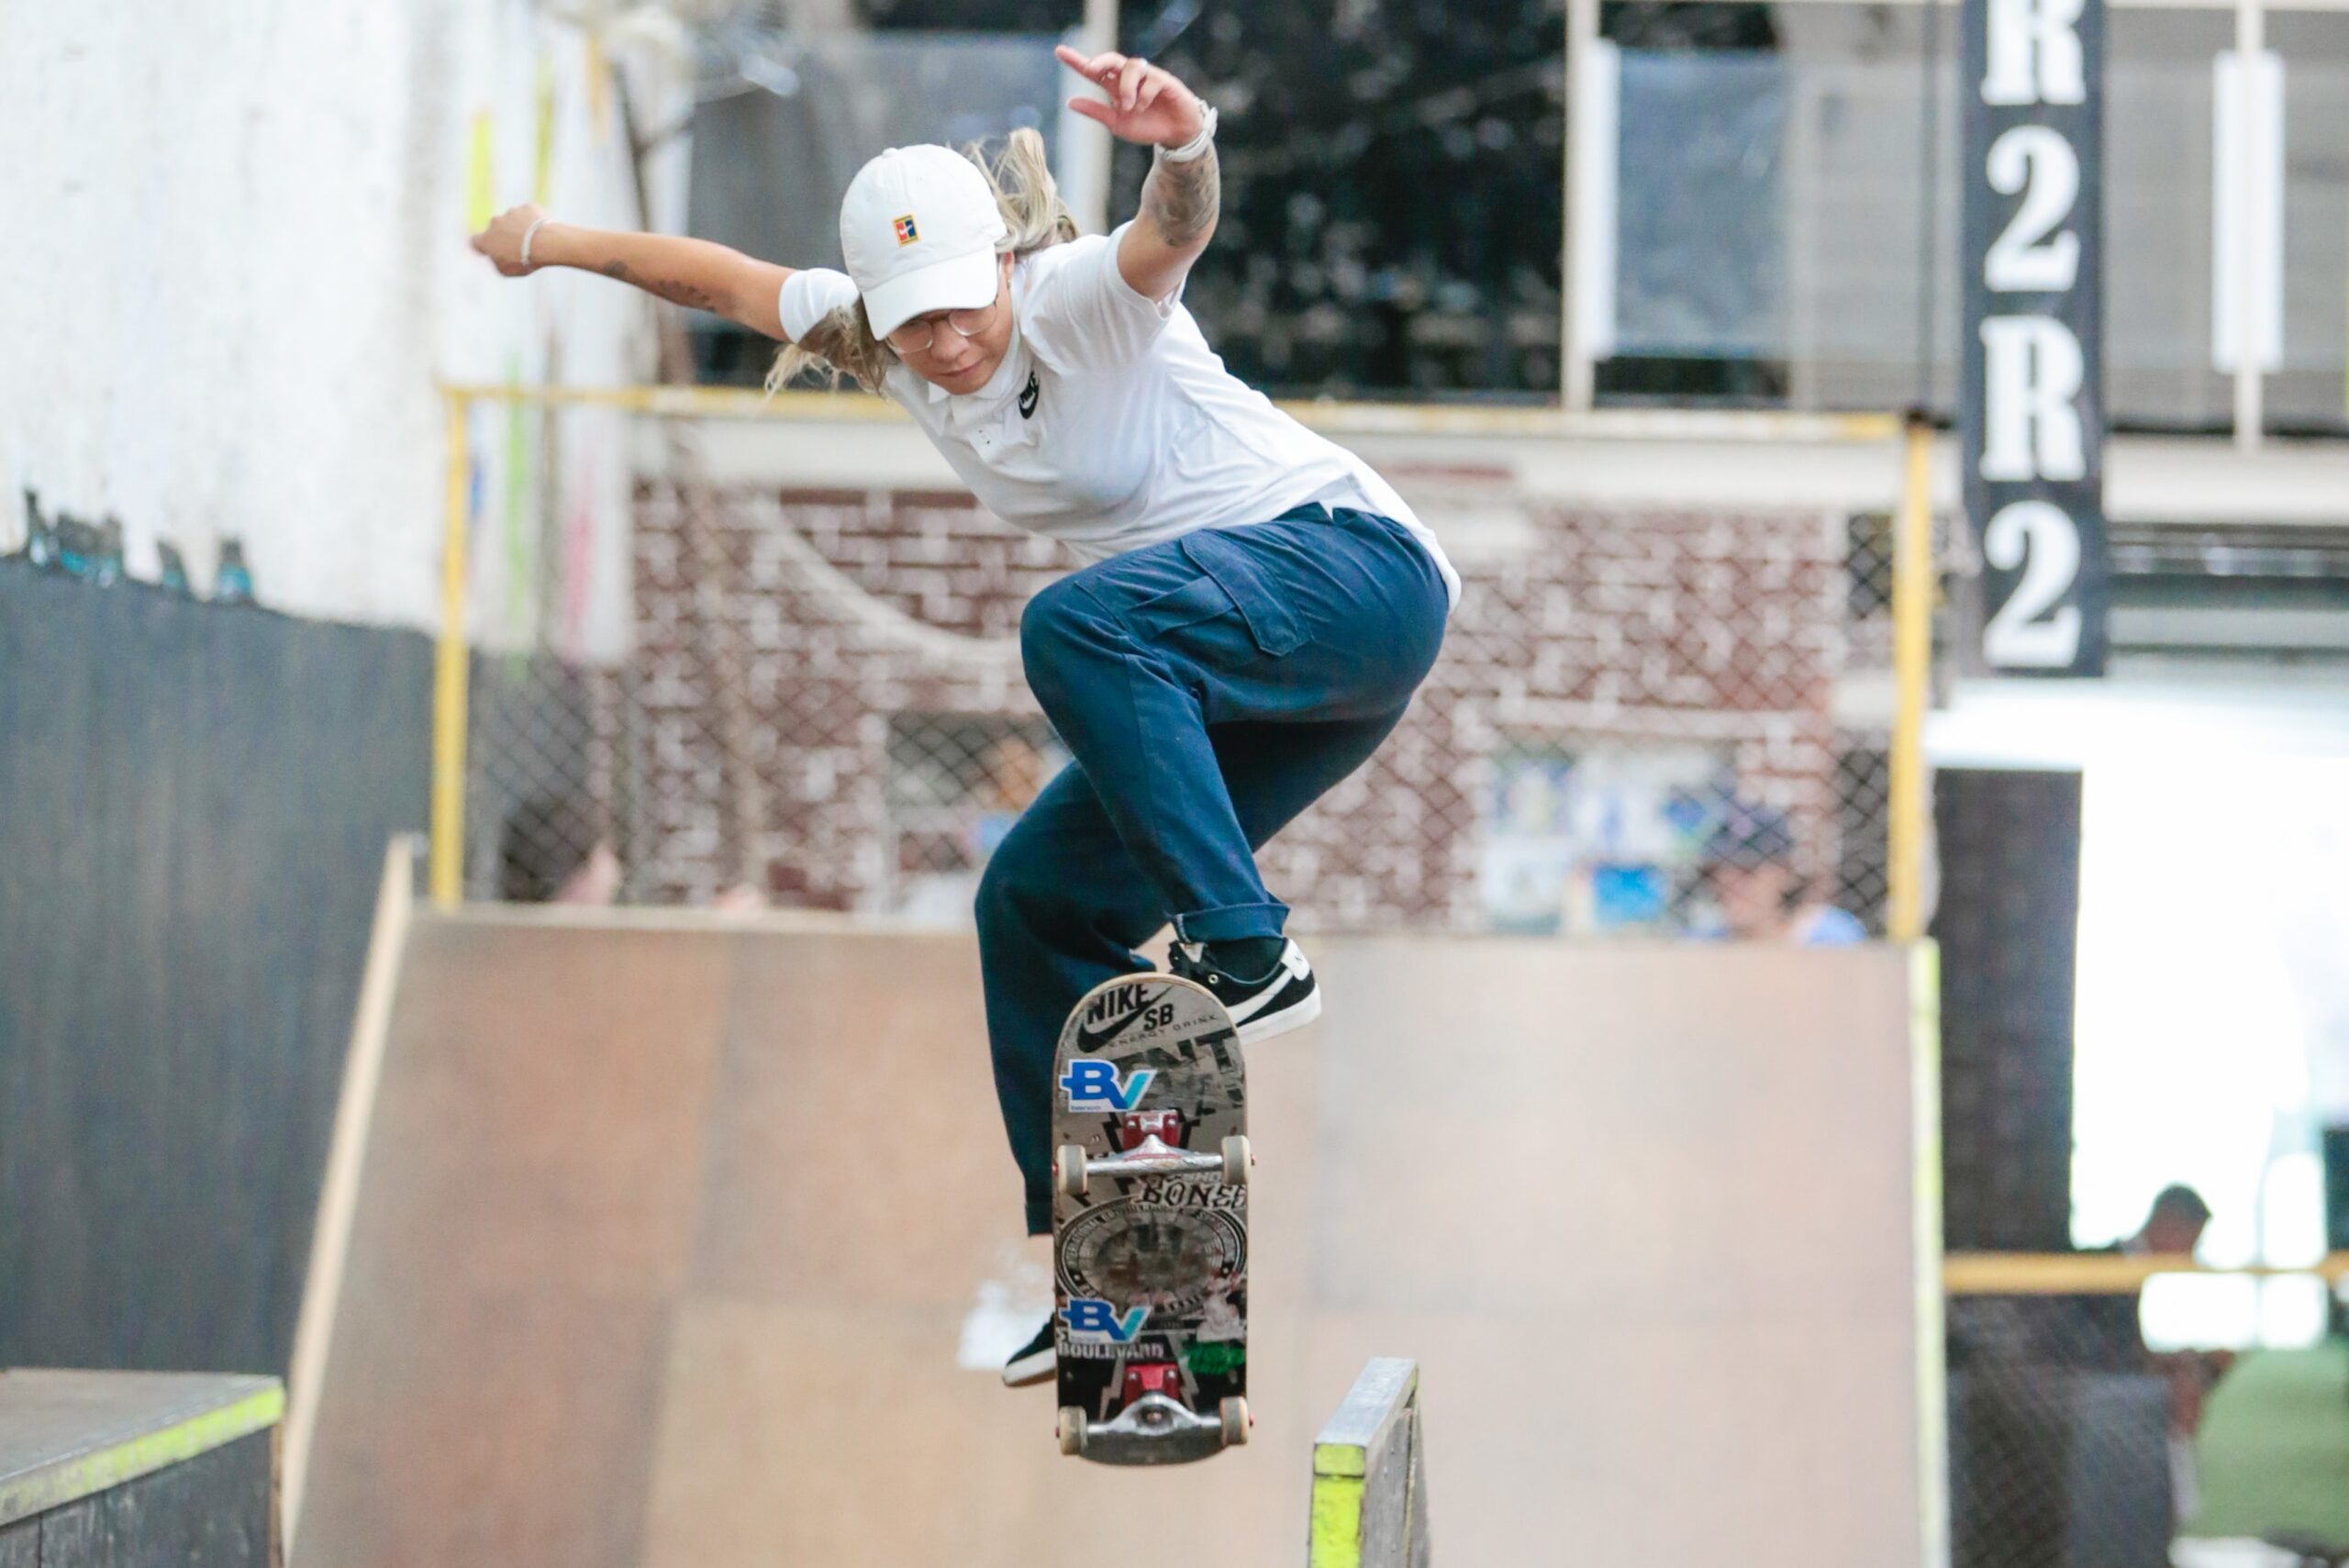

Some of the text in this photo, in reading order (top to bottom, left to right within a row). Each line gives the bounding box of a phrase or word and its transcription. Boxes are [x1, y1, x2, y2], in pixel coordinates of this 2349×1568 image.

[1086, 983, 1151, 1026] NIKE
[1142, 1003, 1174, 1032] SB
[1173, 1013, 1219, 1032] DRINK
